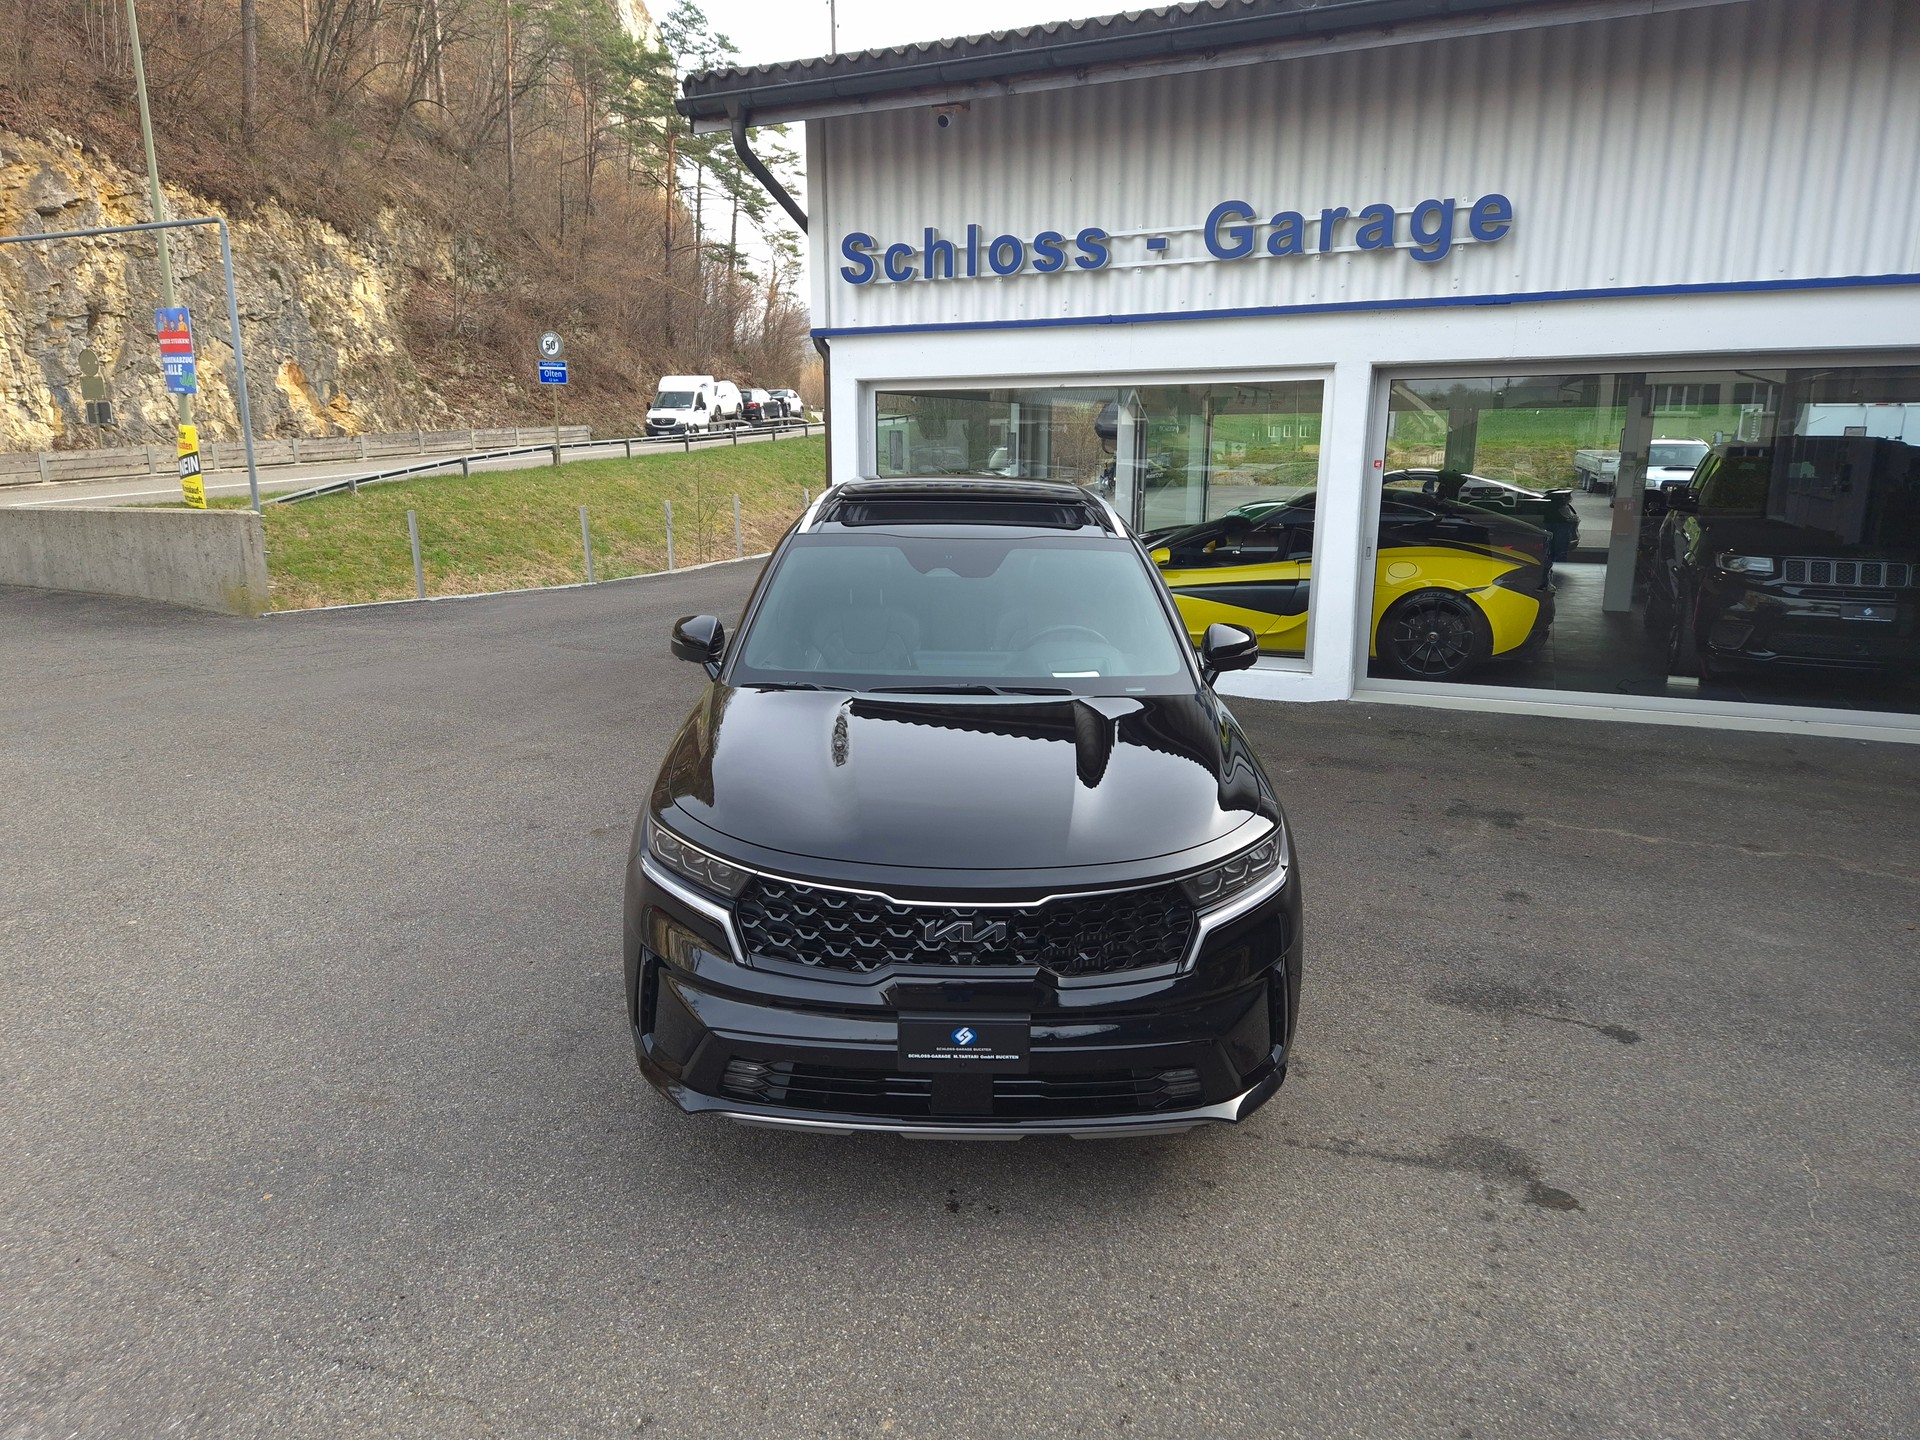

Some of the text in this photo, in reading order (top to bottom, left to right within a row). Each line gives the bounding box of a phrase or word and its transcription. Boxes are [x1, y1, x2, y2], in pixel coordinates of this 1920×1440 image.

[840, 224, 1110, 285] Schloss
[1204, 193, 1513, 262] Garage
[546, 340, 555, 350] 50
[544, 369, 563, 378] Olten
[179, 454, 200, 477] NEIN
[924, 919, 1007, 943] KIA
